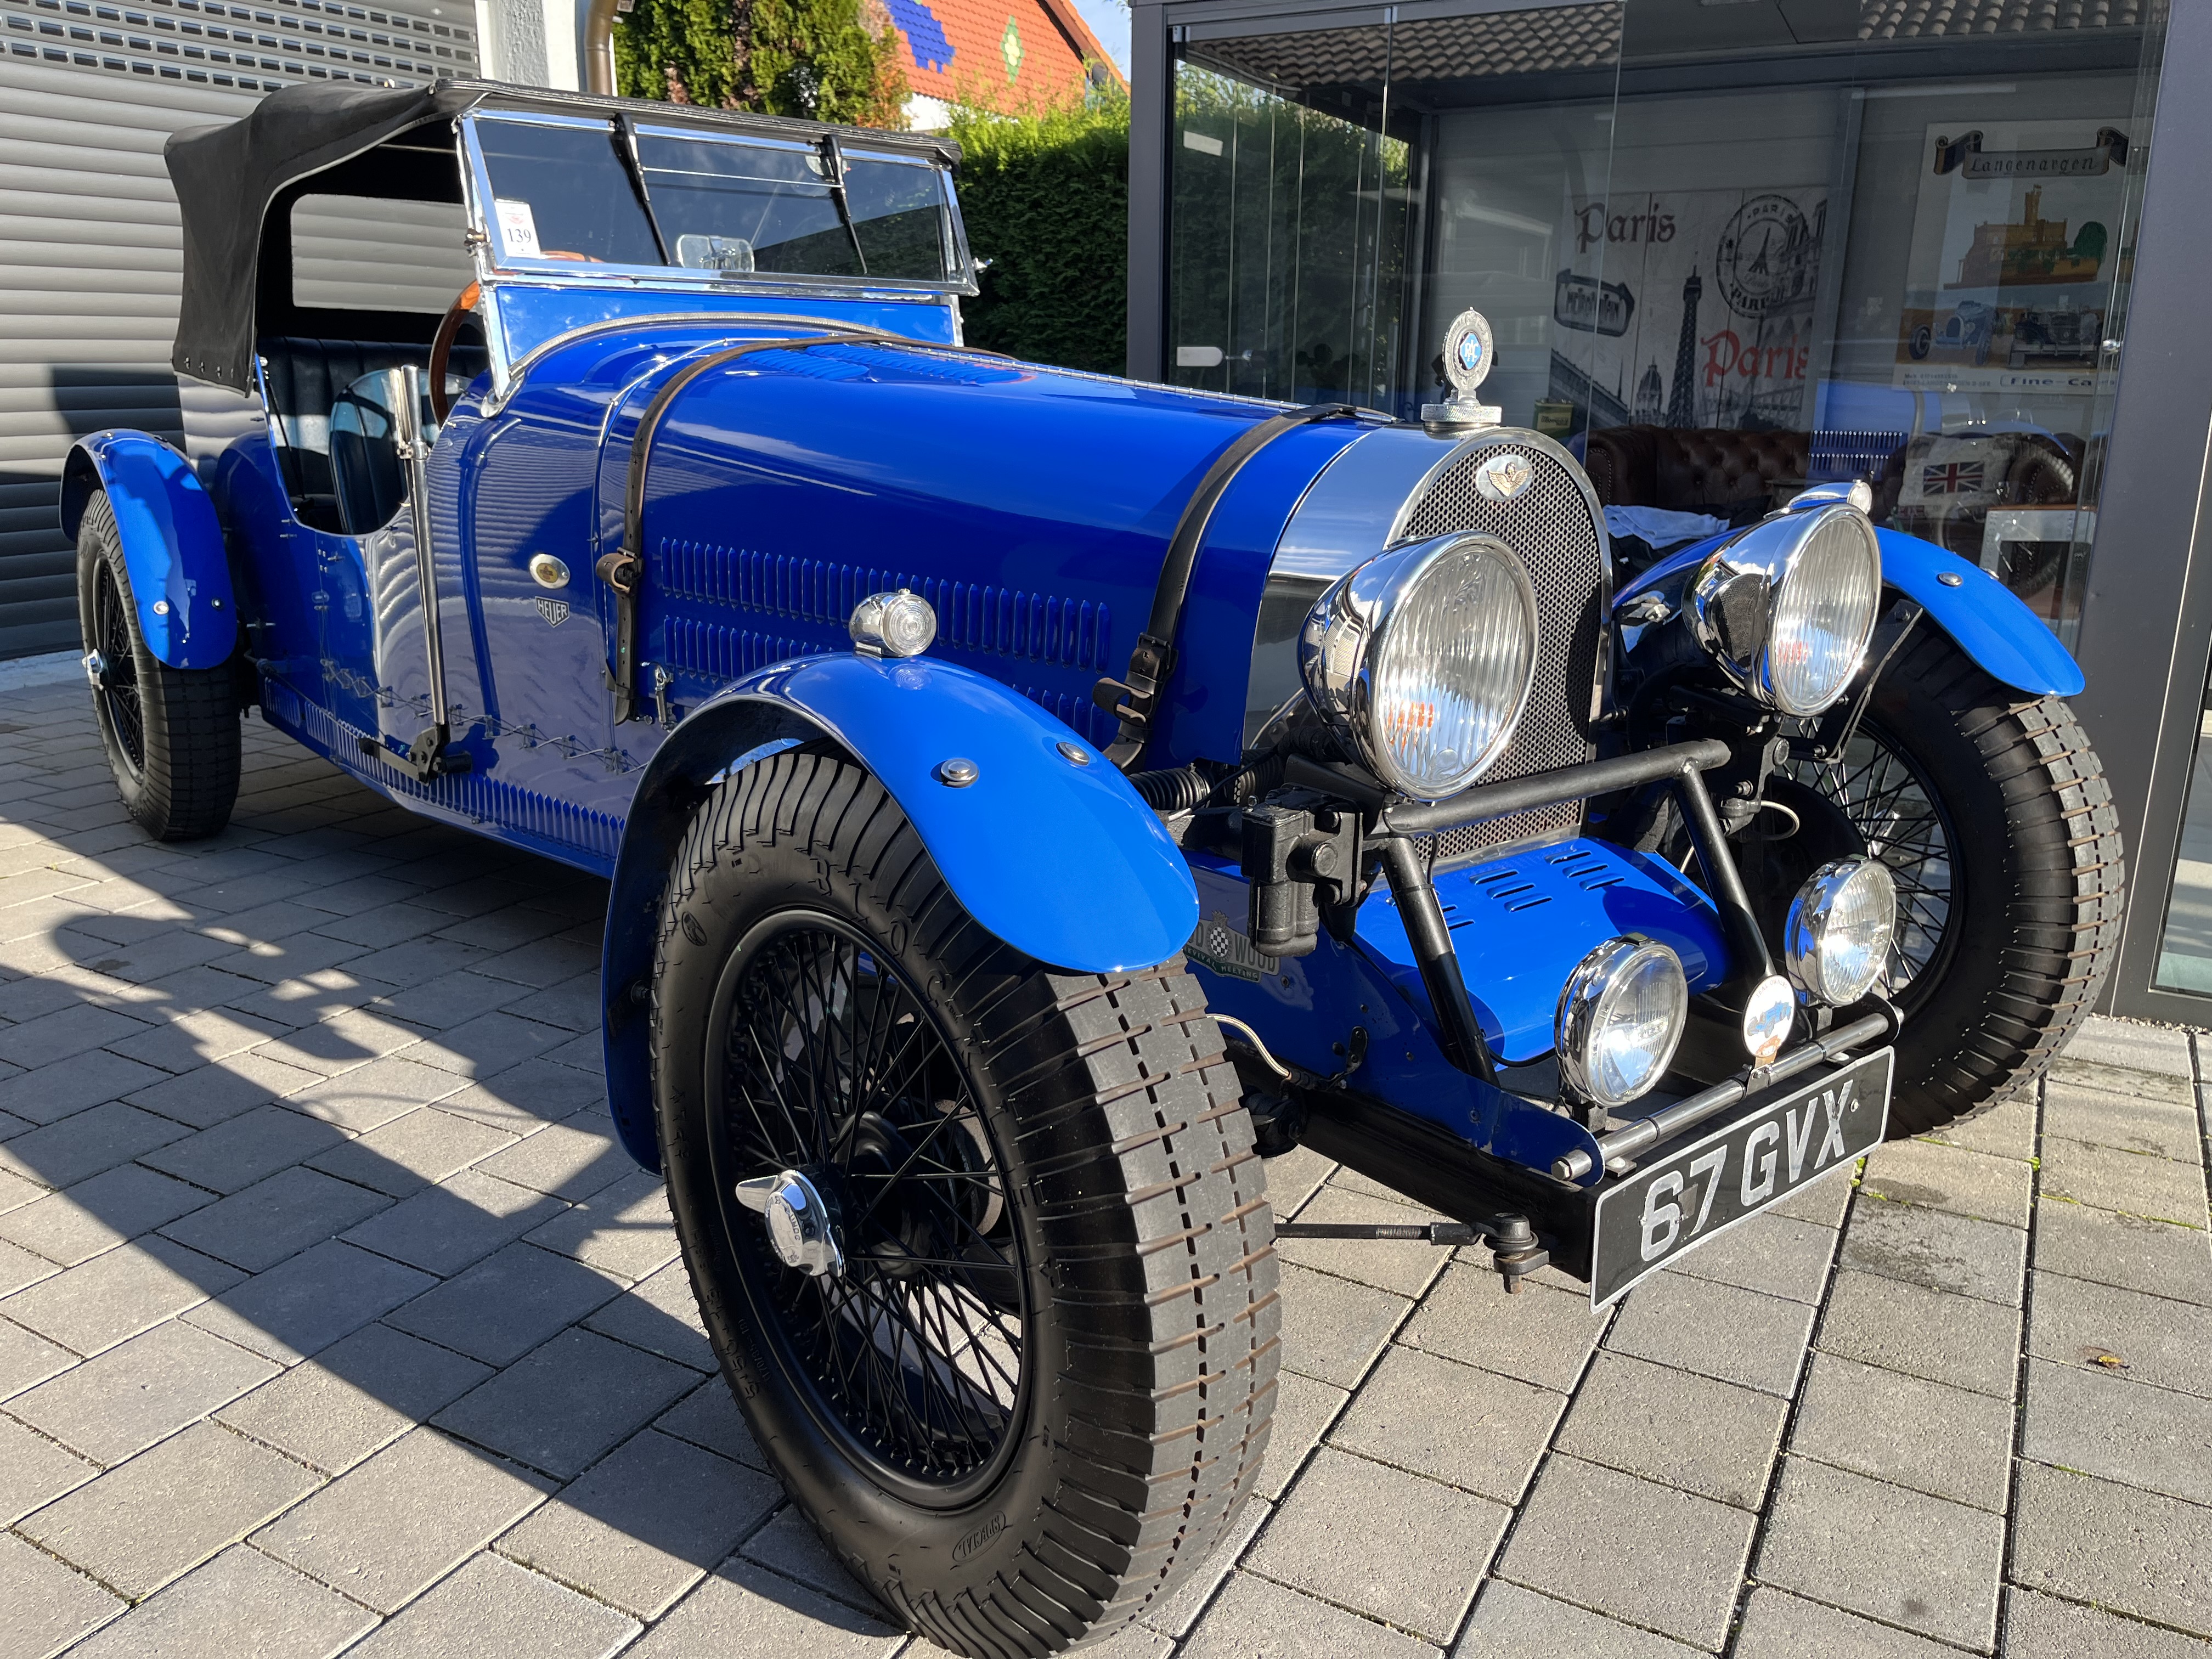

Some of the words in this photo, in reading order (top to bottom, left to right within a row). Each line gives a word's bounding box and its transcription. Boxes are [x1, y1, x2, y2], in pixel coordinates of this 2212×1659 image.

[507, 228, 531, 243] 139
[1575, 202, 1676, 253] Paris
[1700, 330, 1809, 387] Paris
[538, 599, 568, 625] HEUER
[1221, 965, 1258, 979] MEETING
[1640, 1144, 1728, 1262] 67
[1740, 1079, 1853, 1206] GVX
[958, 1514, 1001, 1559] SPECIAL
